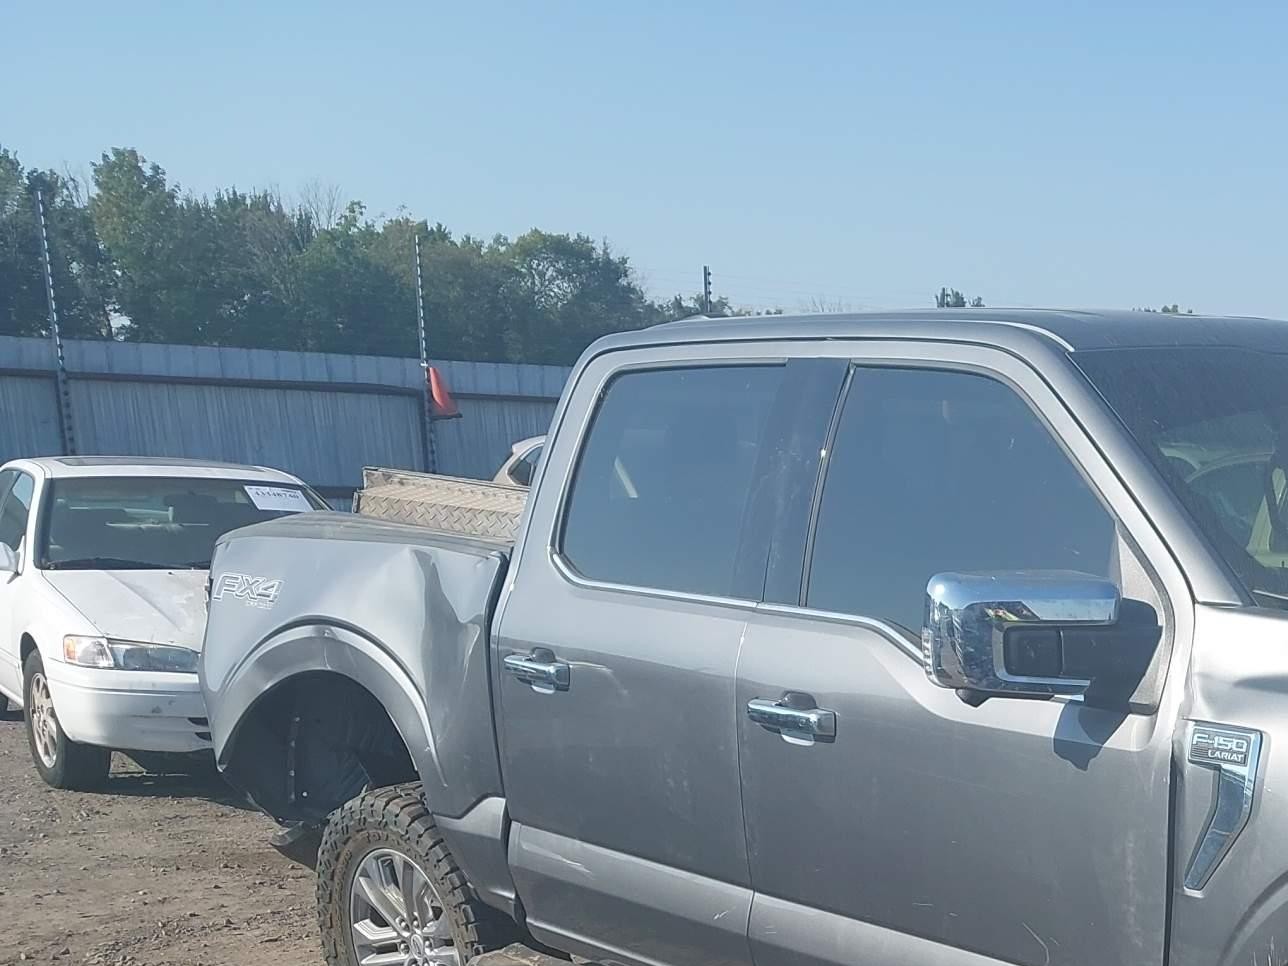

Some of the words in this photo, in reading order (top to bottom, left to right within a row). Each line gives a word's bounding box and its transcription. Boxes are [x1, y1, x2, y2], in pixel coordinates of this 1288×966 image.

[212, 573, 285, 603] FX4
[1192, 733, 1247, 753] F-150
[1207, 749, 1244, 763] LARIAT
